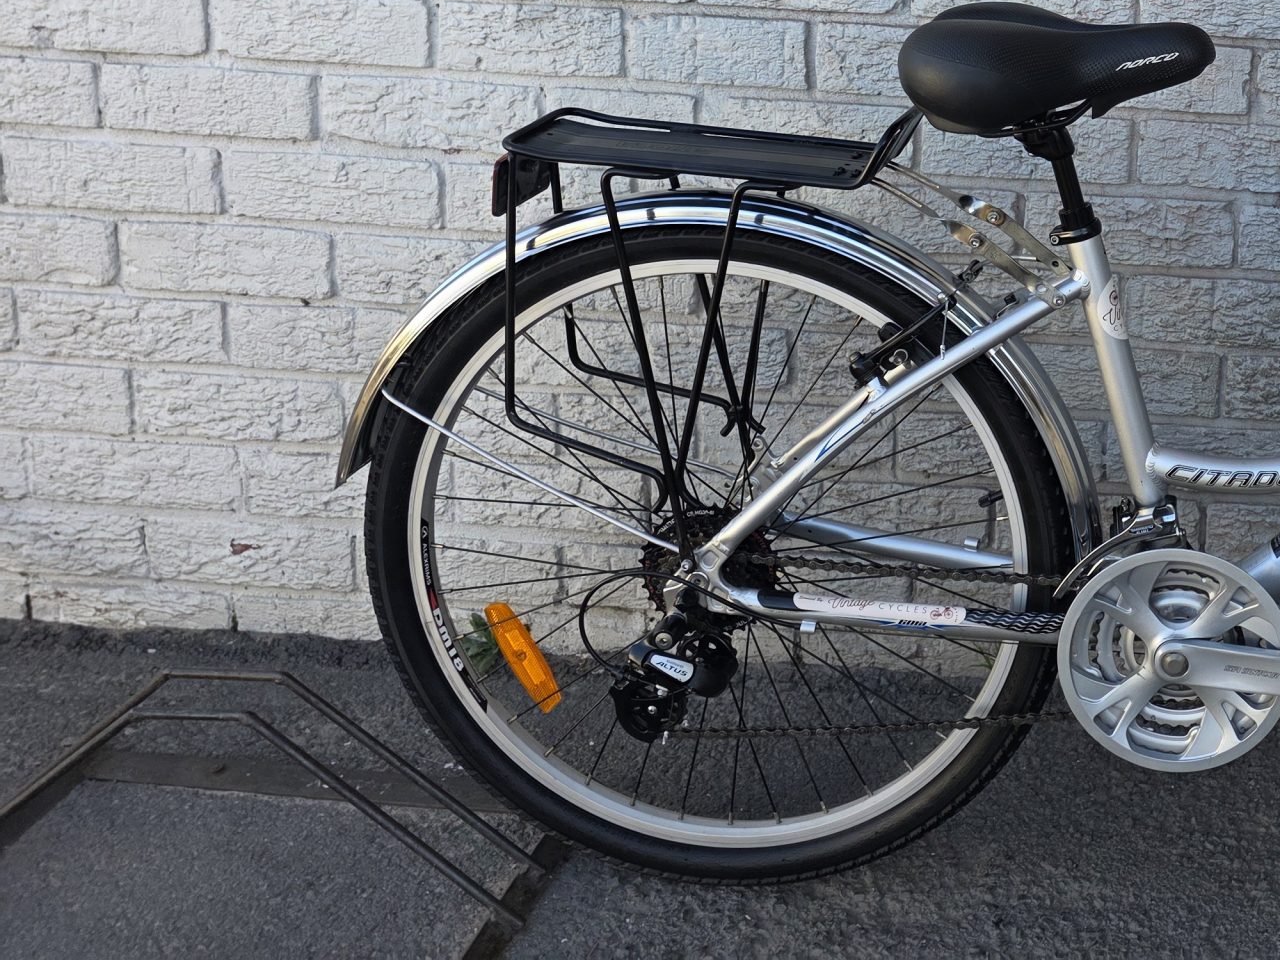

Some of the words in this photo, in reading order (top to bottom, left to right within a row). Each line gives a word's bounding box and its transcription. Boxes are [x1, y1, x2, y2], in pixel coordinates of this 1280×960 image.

[828, 597, 875, 611] Vintage
[879, 604, 927, 614] CYCLES
[656, 661, 688, 676] ALTUS
